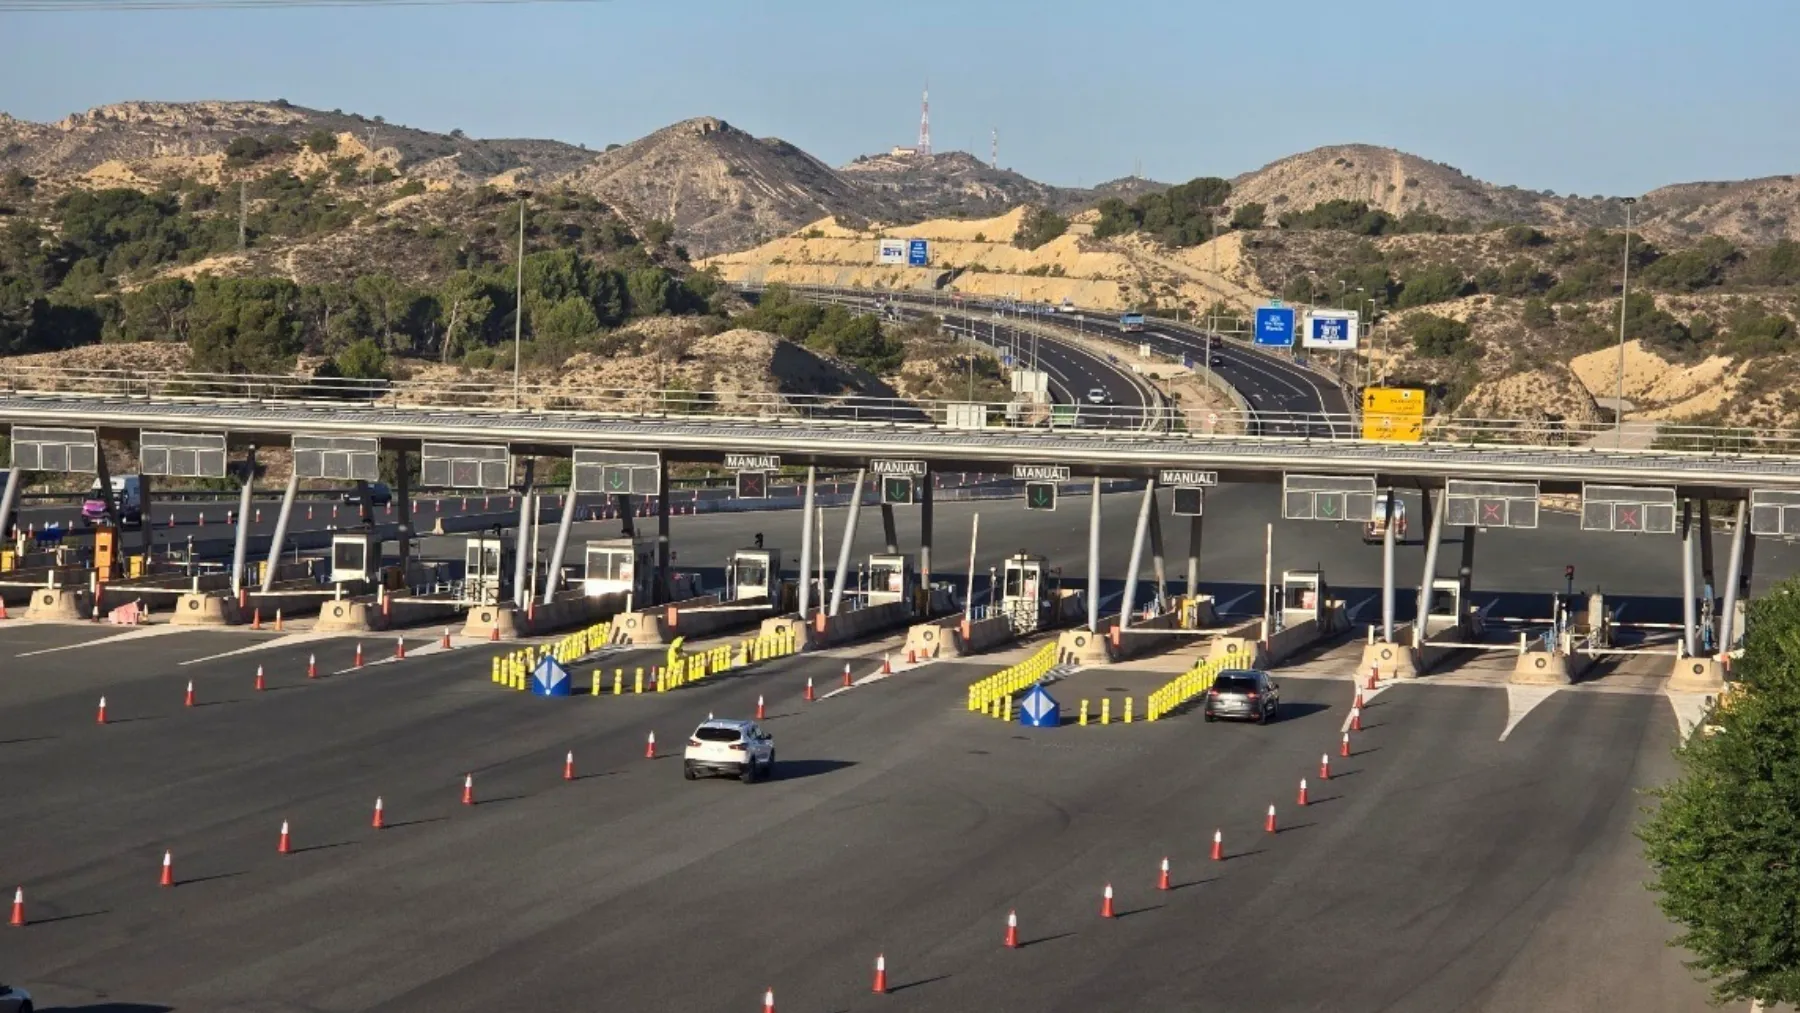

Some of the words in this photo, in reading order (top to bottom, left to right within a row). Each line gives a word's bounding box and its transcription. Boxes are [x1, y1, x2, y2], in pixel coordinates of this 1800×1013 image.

[727, 456, 776, 468] MANUAL
[873, 461, 922, 474] MANUAL
[1016, 467, 1067, 479] MANUAL
[1163, 472, 1214, 484] MANUAL
